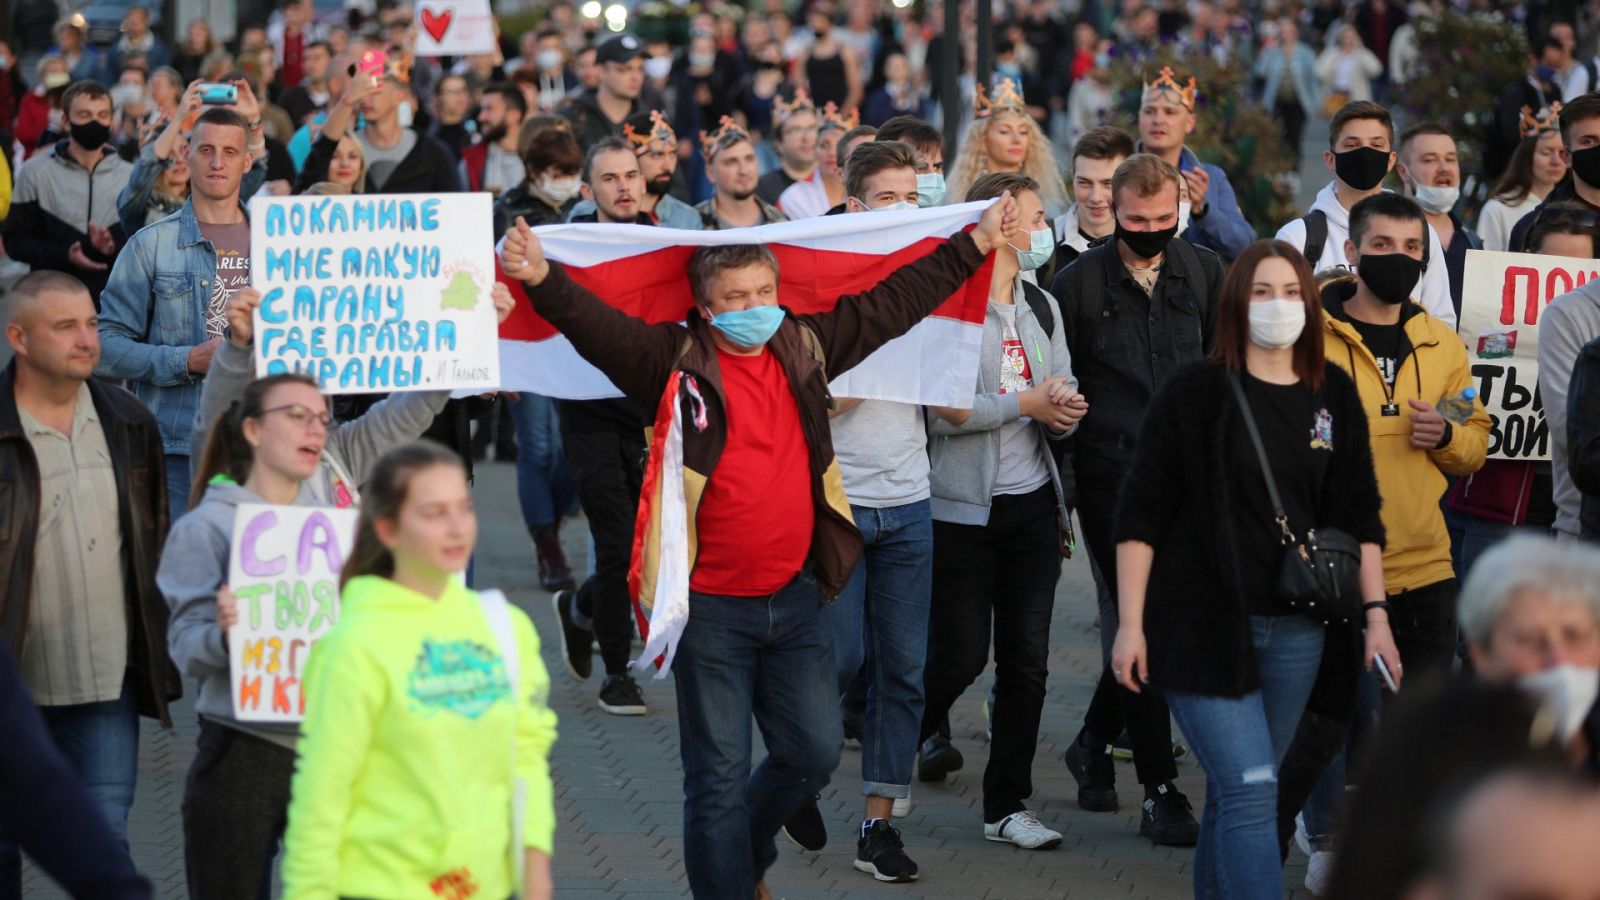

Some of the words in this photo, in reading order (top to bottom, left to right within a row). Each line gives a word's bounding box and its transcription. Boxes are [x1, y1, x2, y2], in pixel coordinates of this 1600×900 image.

[265, 246, 333, 281] МНЕ
[341, 242, 441, 279] ТАКУЮ
[259, 283, 404, 324] СТРАНУ
[1500, 266, 1598, 326] ПО
[261, 326, 329, 359] ГДЕ
[336, 320, 456, 354] ПРАВЯТ
[239, 510, 360, 577] СА
[236, 579, 336, 633] ТВОЯ
[242, 636, 316, 675] ИЗГ
